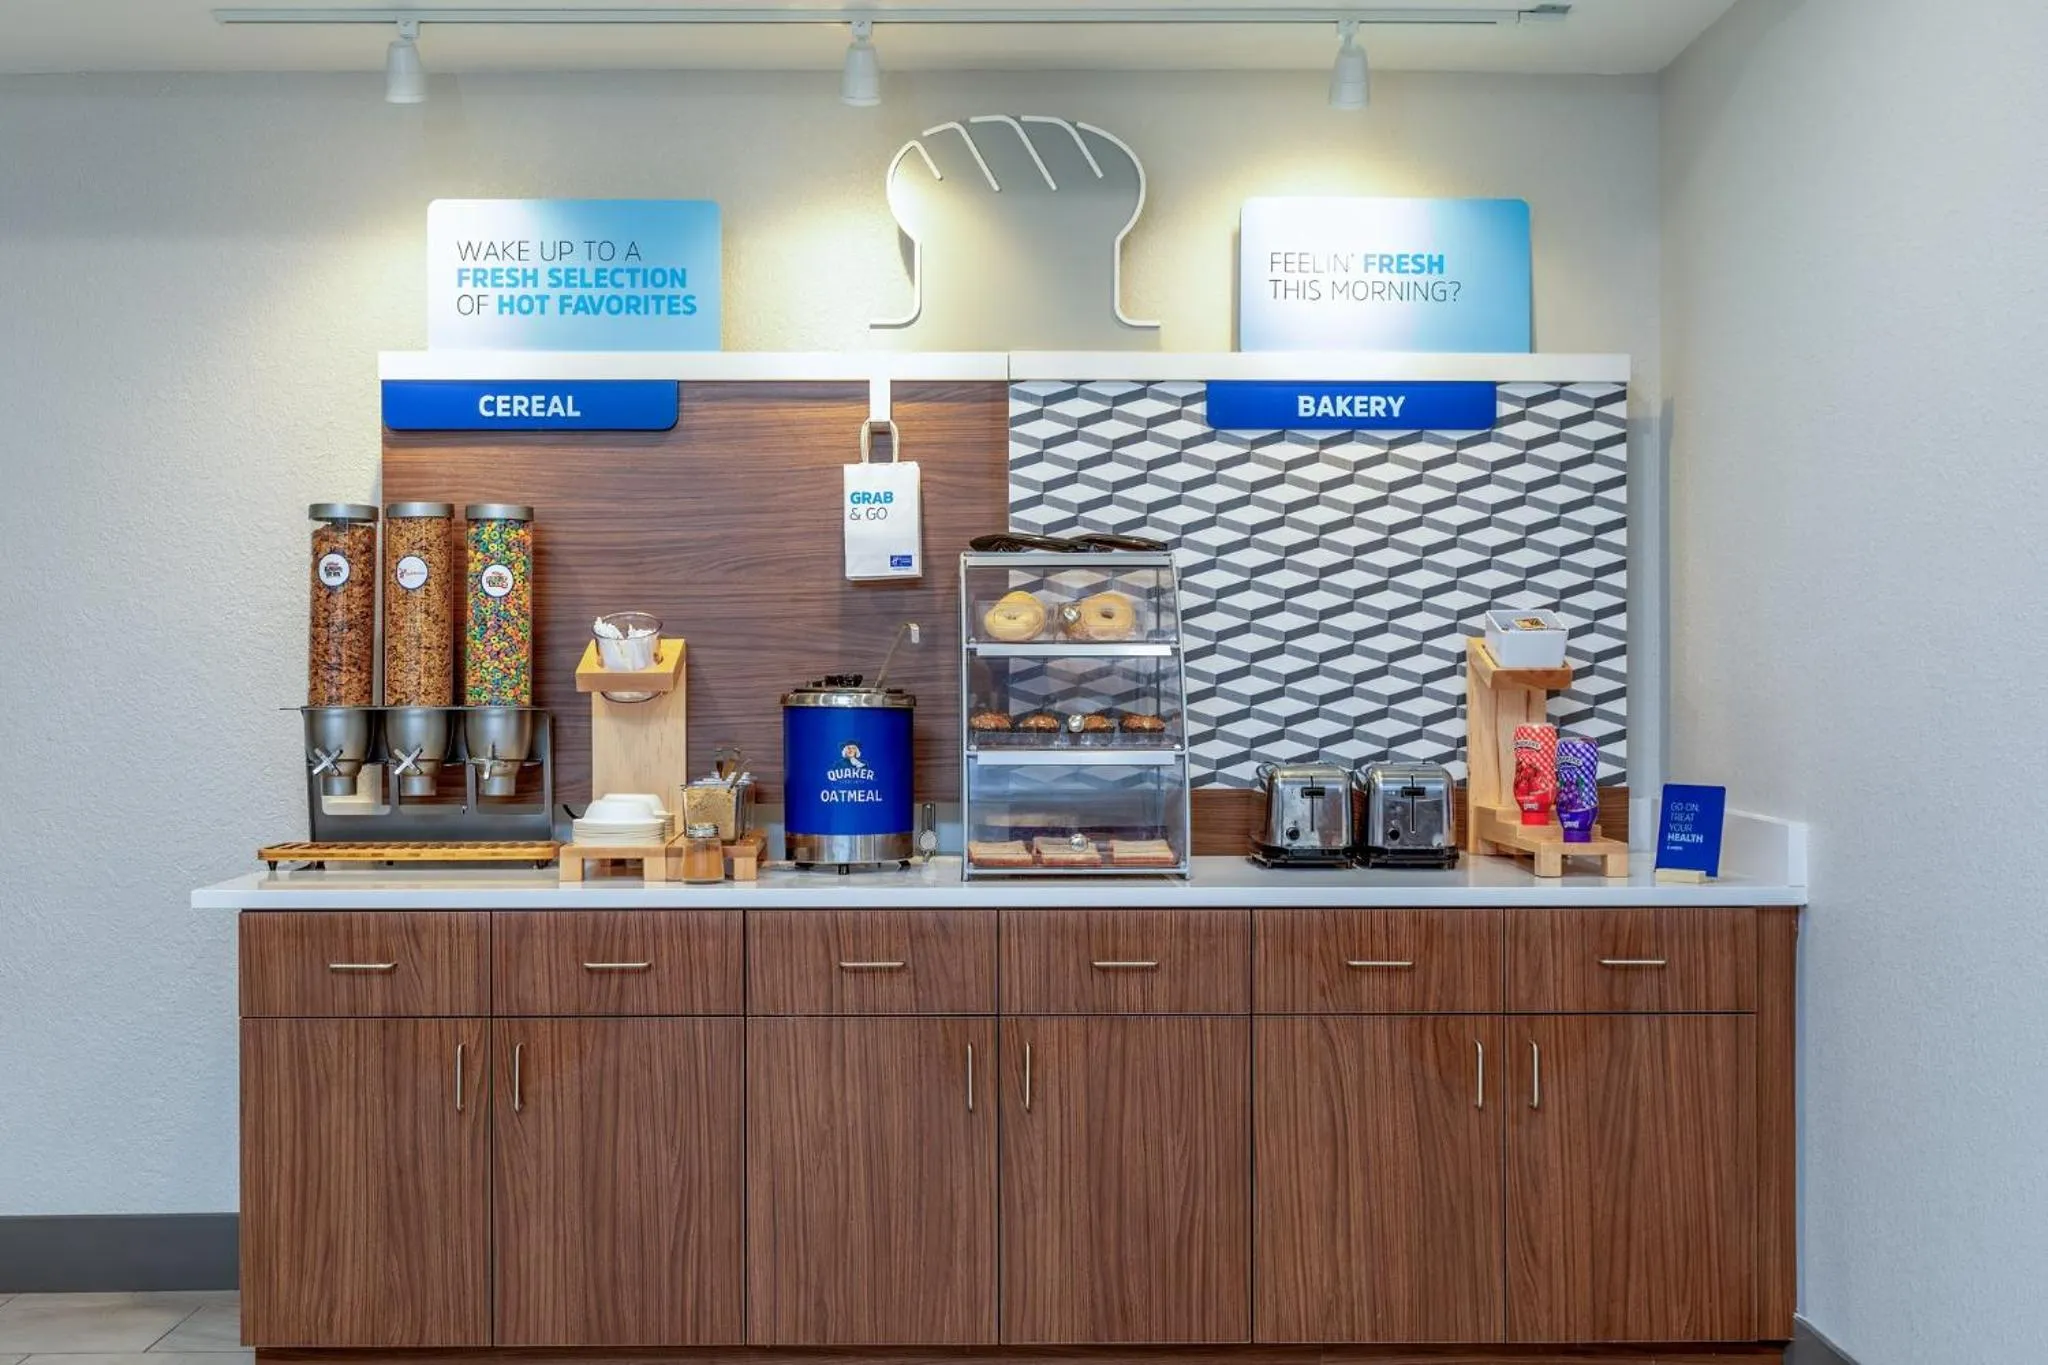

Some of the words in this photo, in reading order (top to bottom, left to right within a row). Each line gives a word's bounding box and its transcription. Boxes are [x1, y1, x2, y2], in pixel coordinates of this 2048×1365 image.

[457, 241, 530, 262] WAKE
[541, 241, 573, 262] UP
[584, 241, 615, 262] TO
[625, 241, 641, 262] A
[1270, 252, 1354, 274] FEELIN'
[1364, 254, 1444, 274] FRESH
[457, 268, 538, 289] FRESH
[548, 268, 686, 289] SELECTION
[1269, 279, 1321, 300] THIS
[1332, 280, 1462, 302] MORNING?
[457, 294, 489, 315] OF
[498, 295, 550, 315] HOT
[559, 295, 697, 315] FAVORITES
[479, 395, 581, 417] CEREAL
[1297, 395, 1405, 417] BAKERY
[850, 491, 893, 504] GRAB
[850, 507, 861, 520] &
[866, 507, 888, 520] GO
[827, 768, 874, 781] QUAKER
[820, 789, 883, 802] OATMEAL
[1667, 832, 1704, 843] HEALTH
[1669, 823, 1692, 832] YOUR
